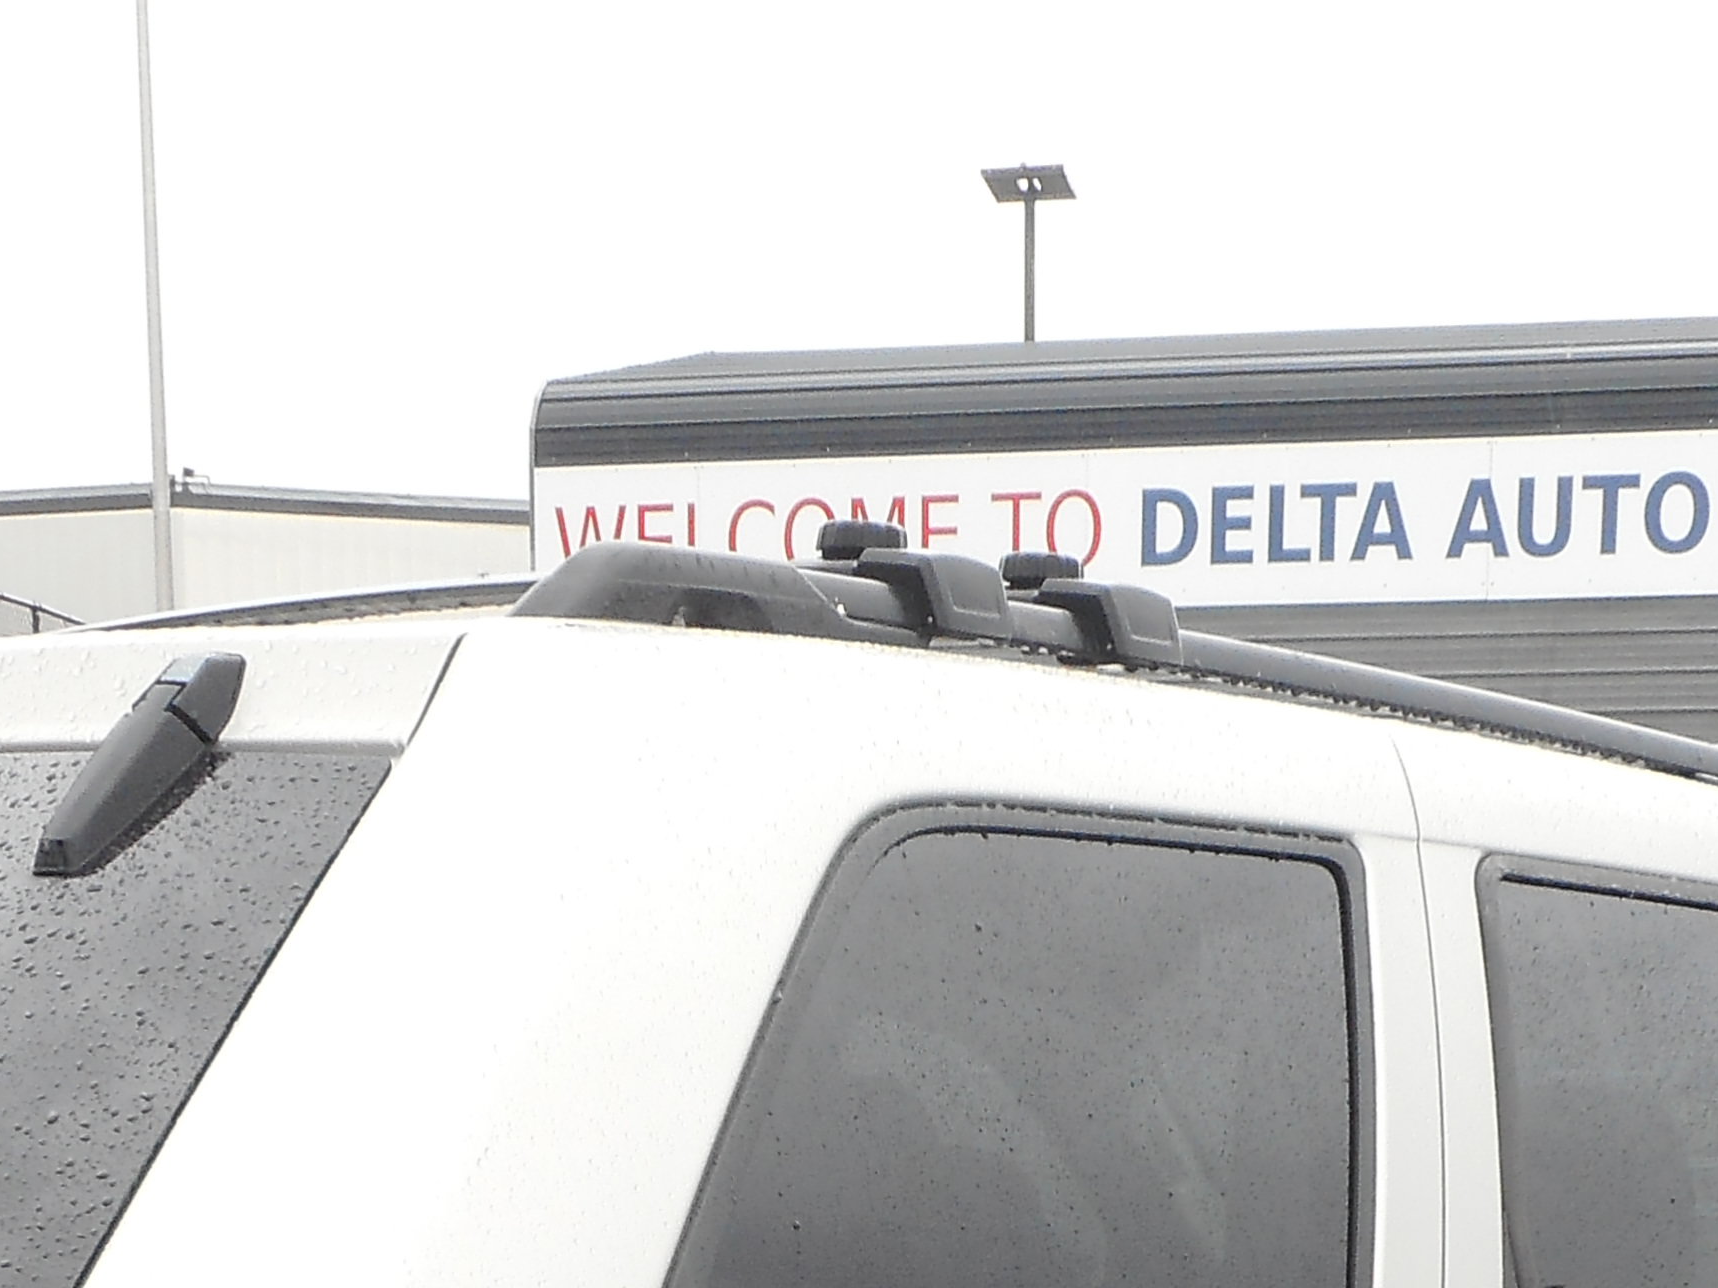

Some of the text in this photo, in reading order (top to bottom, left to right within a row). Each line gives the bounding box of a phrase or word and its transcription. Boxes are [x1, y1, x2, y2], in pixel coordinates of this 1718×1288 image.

[991, 488, 1102, 566] TO
[1139, 480, 1414, 567] DELTA
[1445, 470, 1711, 560] AUTO
